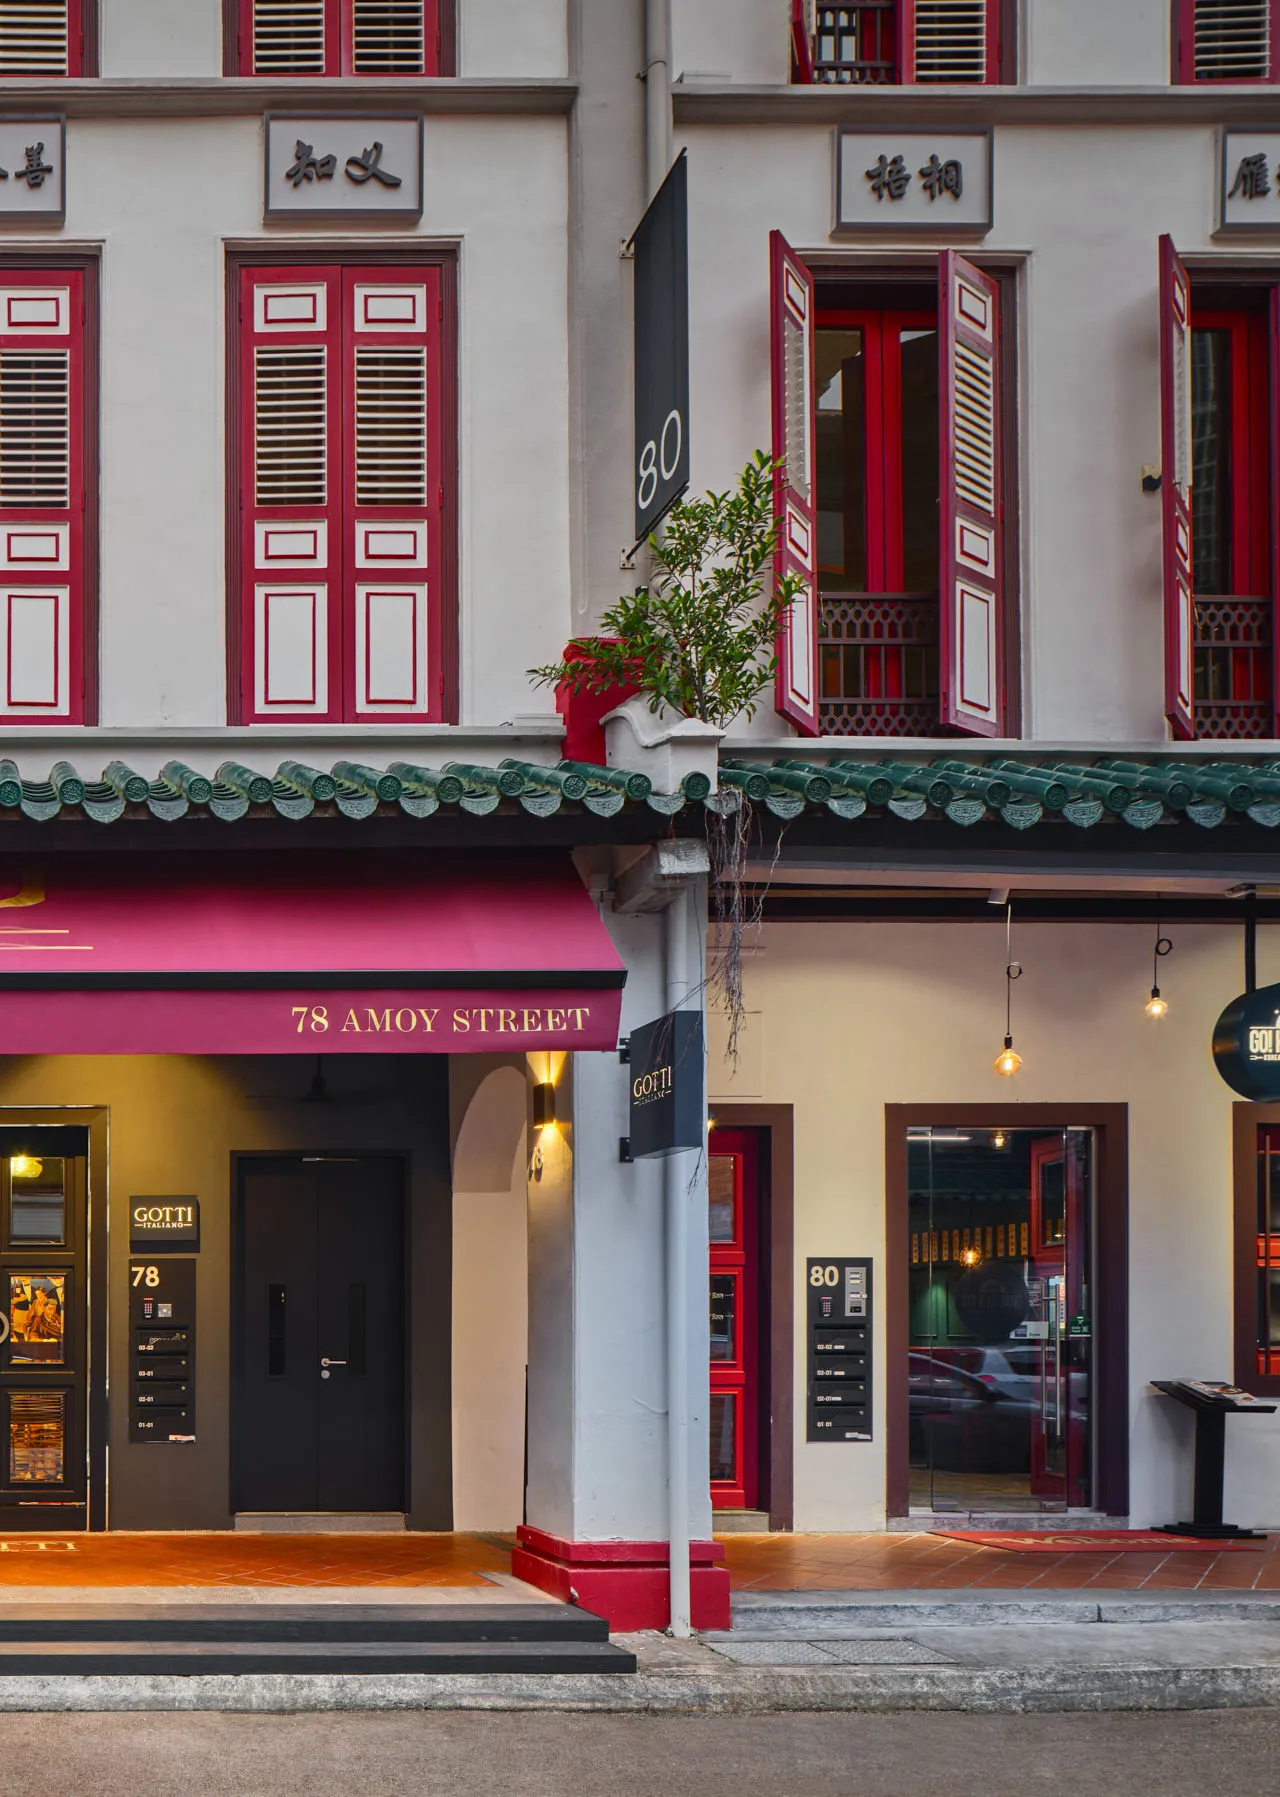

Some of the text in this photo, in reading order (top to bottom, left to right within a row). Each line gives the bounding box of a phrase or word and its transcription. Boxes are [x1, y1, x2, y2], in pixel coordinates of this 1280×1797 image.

[866, 153, 962, 200] 梧桐
[1228, 152, 1280, 199] 雁
[639, 409, 681, 509] 80
[291, 1006, 590, 1033] 78 AMOY STREET
[633, 1066, 672, 1098] GOTTI
[134, 1207, 192, 1222] GOTTI
[131, 1266, 160, 1287] 78
[810, 1266, 839, 1287] 80
